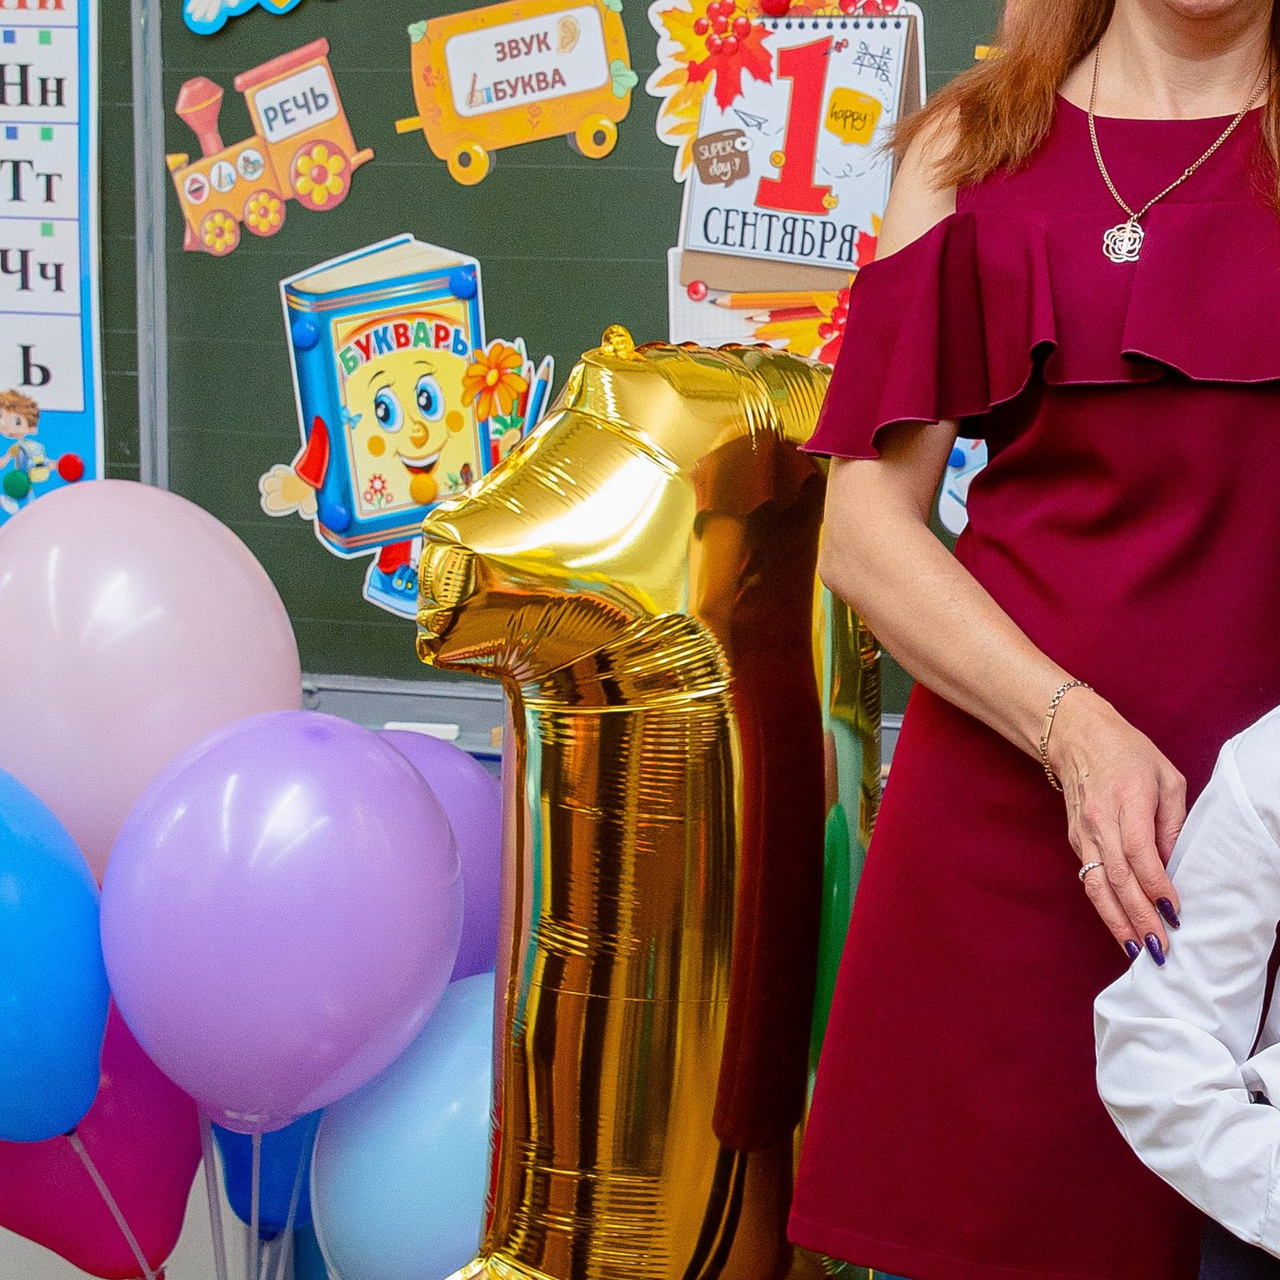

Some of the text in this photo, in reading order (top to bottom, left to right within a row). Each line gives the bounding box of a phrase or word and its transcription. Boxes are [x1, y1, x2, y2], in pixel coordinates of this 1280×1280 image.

[494, 31, 552, 64] ЗВУК
[493, 67, 567, 102] БУКВА
[263, 86, 330, 133] РЕЧЬ
[754, 35, 834, 216] 1
[699, 140, 735, 160] SUPER
[0, 160, 63, 203] Тт
[703, 206, 858, 263] СЕНТЯБРЯ
[19, 345, 51, 387] Ь
[338, 321, 470, 375] БУКВАРЬ
